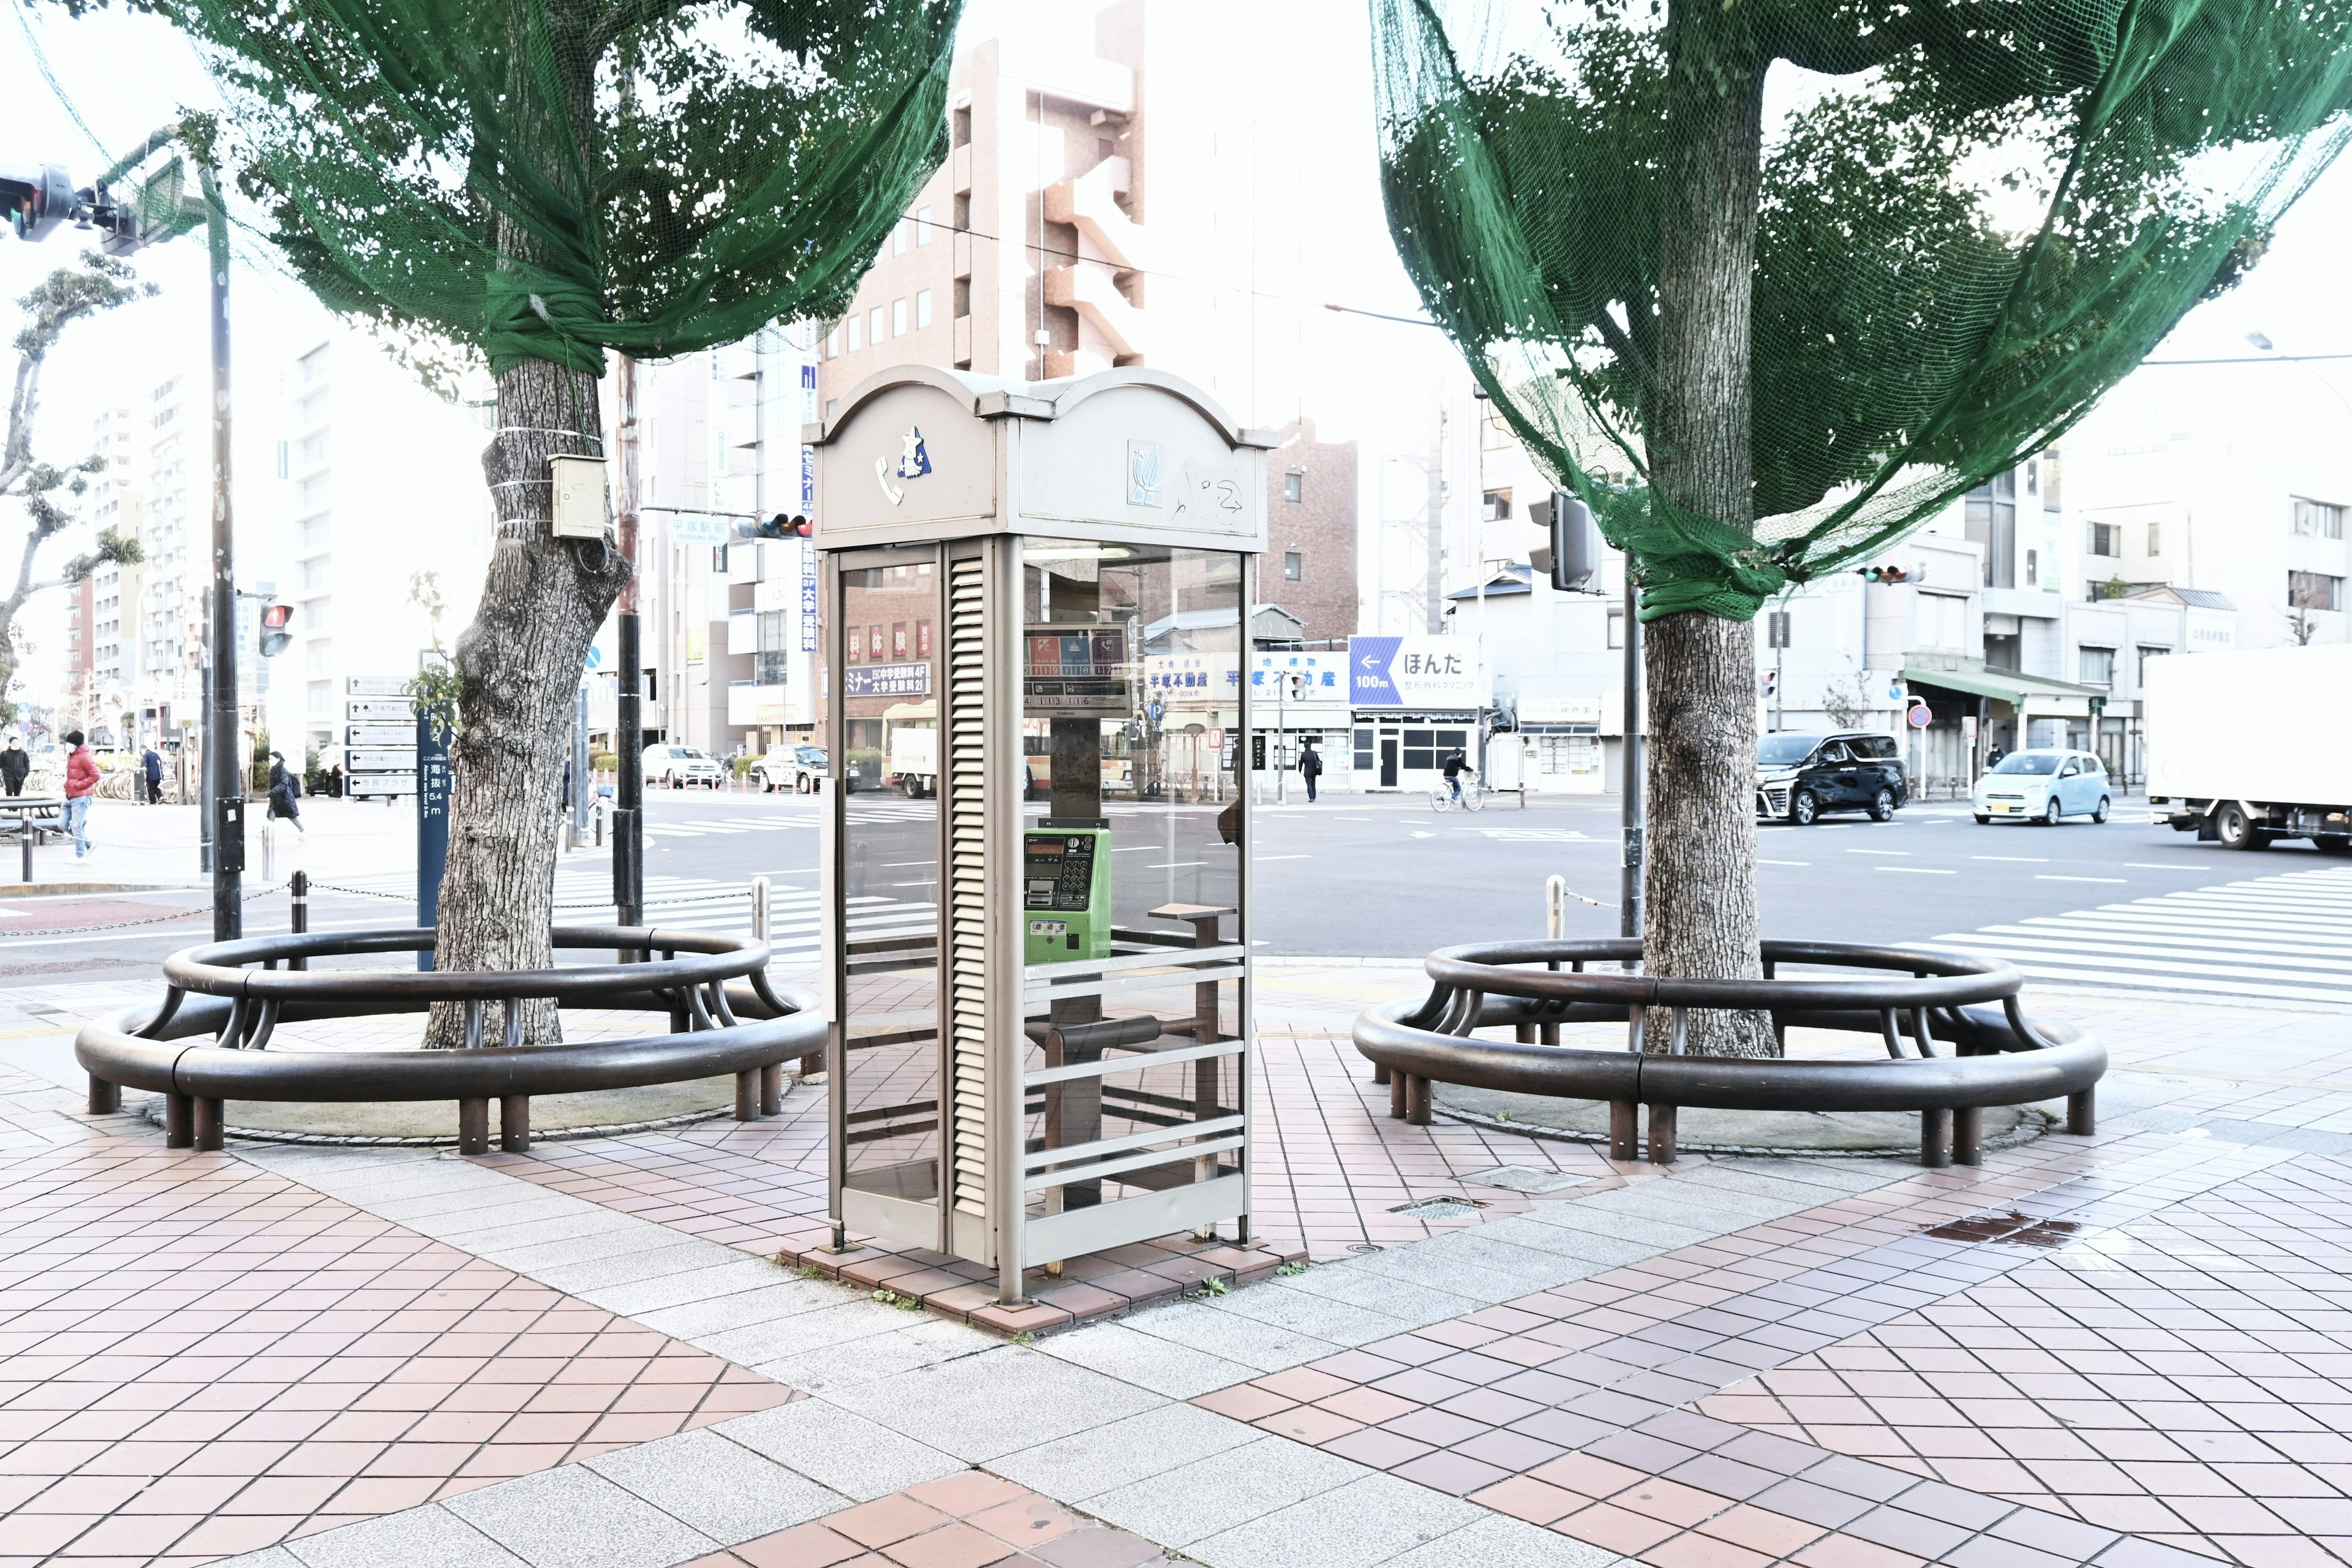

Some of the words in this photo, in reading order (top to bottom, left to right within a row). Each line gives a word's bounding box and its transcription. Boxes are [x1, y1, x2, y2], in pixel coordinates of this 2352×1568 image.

[672, 519, 725, 534] 平塚駅前
[1404, 653, 1461, 674] ほんだ
[914, 666, 925, 677] 4F
[846, 672, 871, 692] ミナー
[872, 679, 914, 692] 大学受験科
[1149, 672, 1207, 688] 平塚不動産
[1356, 676, 1389, 688] 100m
[1404, 680, 1474, 690] 整形外科クリニック
[431, 764, 441, 788] 海抜
[429, 793, 443, 801] 5.4
